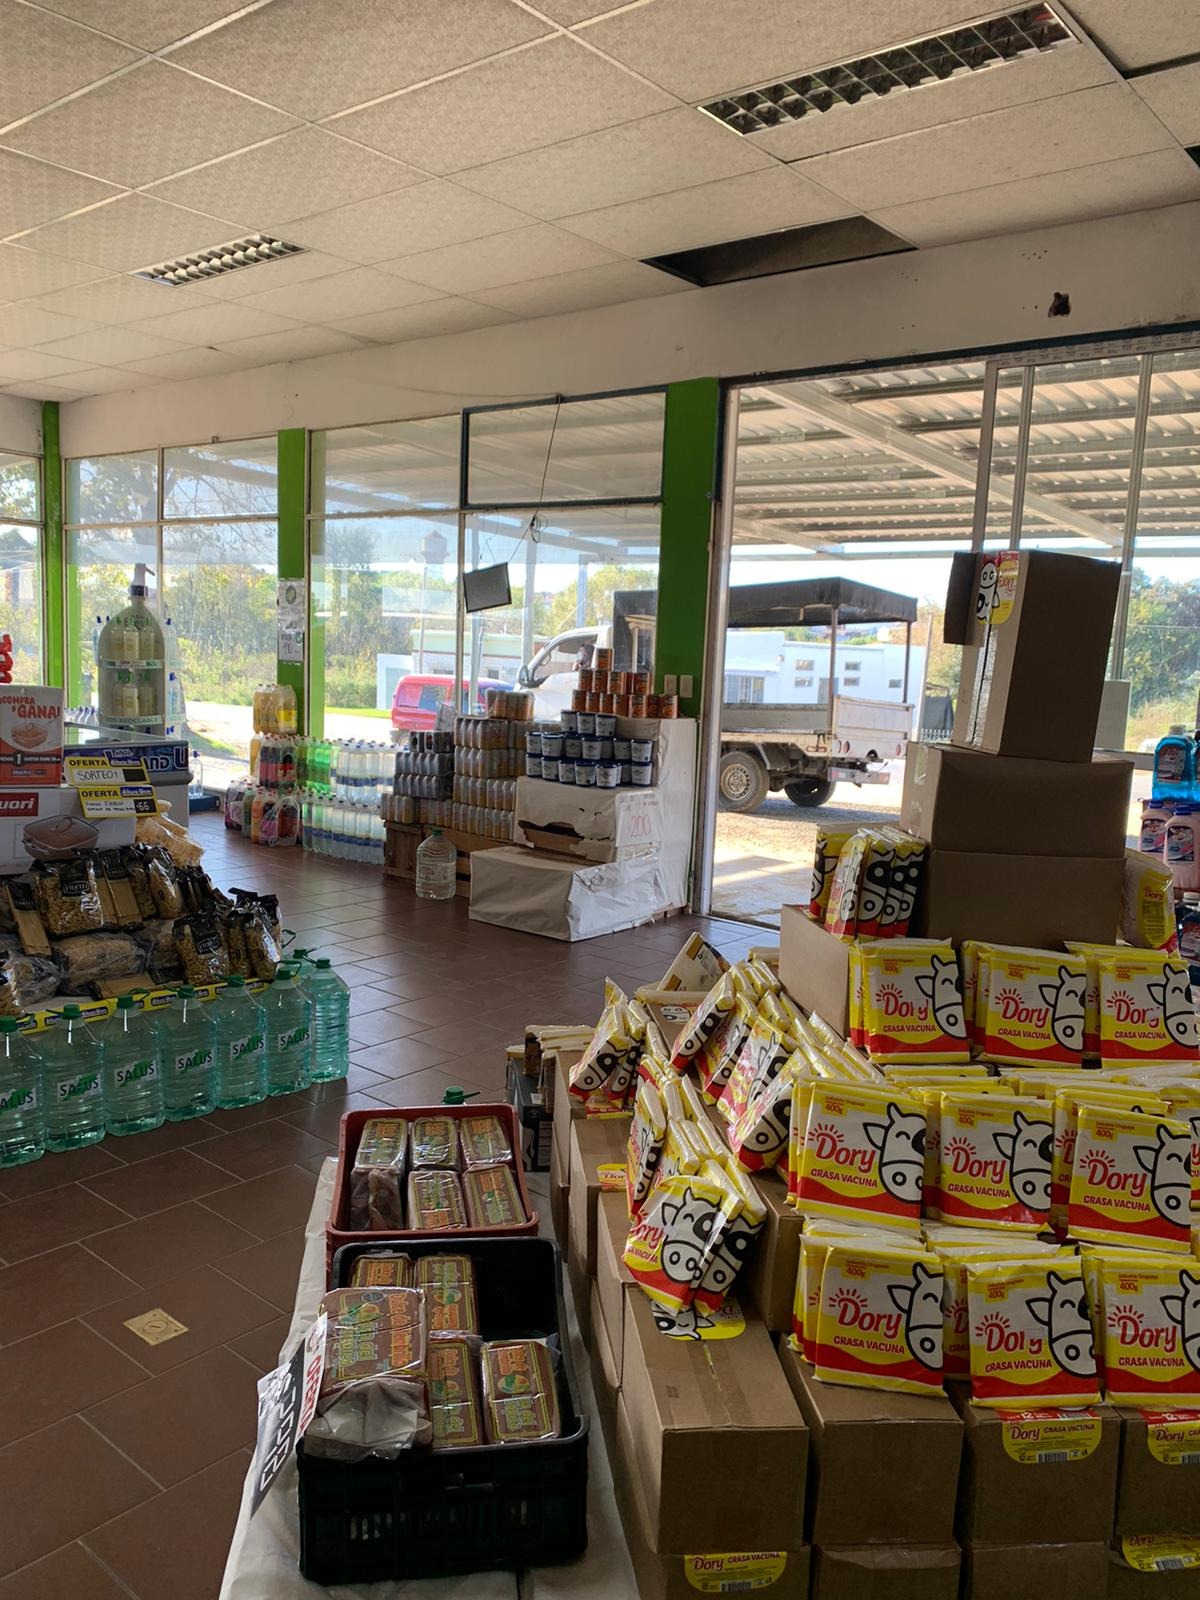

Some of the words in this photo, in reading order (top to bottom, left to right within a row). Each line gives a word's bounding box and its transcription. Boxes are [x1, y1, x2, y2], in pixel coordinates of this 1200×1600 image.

[69, 759, 107, 767] OFERTA
[82, 790, 119, 798] OFERTA
[1002, 996, 1050, 1029] Dory
[280, 1028, 310, 1047] SALUS
[883, 1024, 905, 1033] GRASA
[907, 1024, 936, 1033] VACUNA
[998, 1028, 1020, 1037] GRASA
[1022, 1030, 1051, 1040] VACUNA
[1137, 1032, 1166, 1040] VACUNA
[232, 1035, 264, 1056] SALUS
[178, 1052, 213, 1070] SALUS
[116, 1062, 156, 1082] SALUS
[60, 1078, 99, 1098] SALUS
[1096, 1128, 1114, 1140] 400g
[816, 1132, 876, 1174] Dory
[952, 1146, 1007, 1184] Dory
[810, 1168, 840, 1180] GRASA
[841, 1173, 878, 1188] VACUNA
[1088, 1158, 1148, 1198] Dory
[948, 1183, 975, 1194] GRASA
[976, 1186, 1011, 1198] VACUNA
[1083, 1195, 1112, 1207] GRASA
[1114, 1200, 1151, 1212] VACUNA
[838, 1297, 903, 1339] Dory
[1117, 1315, 1178, 1354] Dory
[833, 1335, 865, 1348] GRASA
[866, 1341, 905, 1354] VACUNA
[985, 1361, 1013, 1373] GRASA
[1014, 1359, 1053, 1370] VACUNA
[1118, 1356, 1148, 1367] GRASA
[1148, 1357, 1185, 1368] VACUNA
[300, 1356, 322, 1430] OFERTA
[1010, 1426, 1041, 1440] Dory
[1044, 1426, 1067, 1434] GRASA
[1068, 1424, 1095, 1432] VACUNA
[1155, 1428, 1184, 1442] Dory
[694, 1556, 724, 1572] Dory
[728, 1555, 751, 1563] GRASA
[752, 1552, 780, 1560] VACUNA
